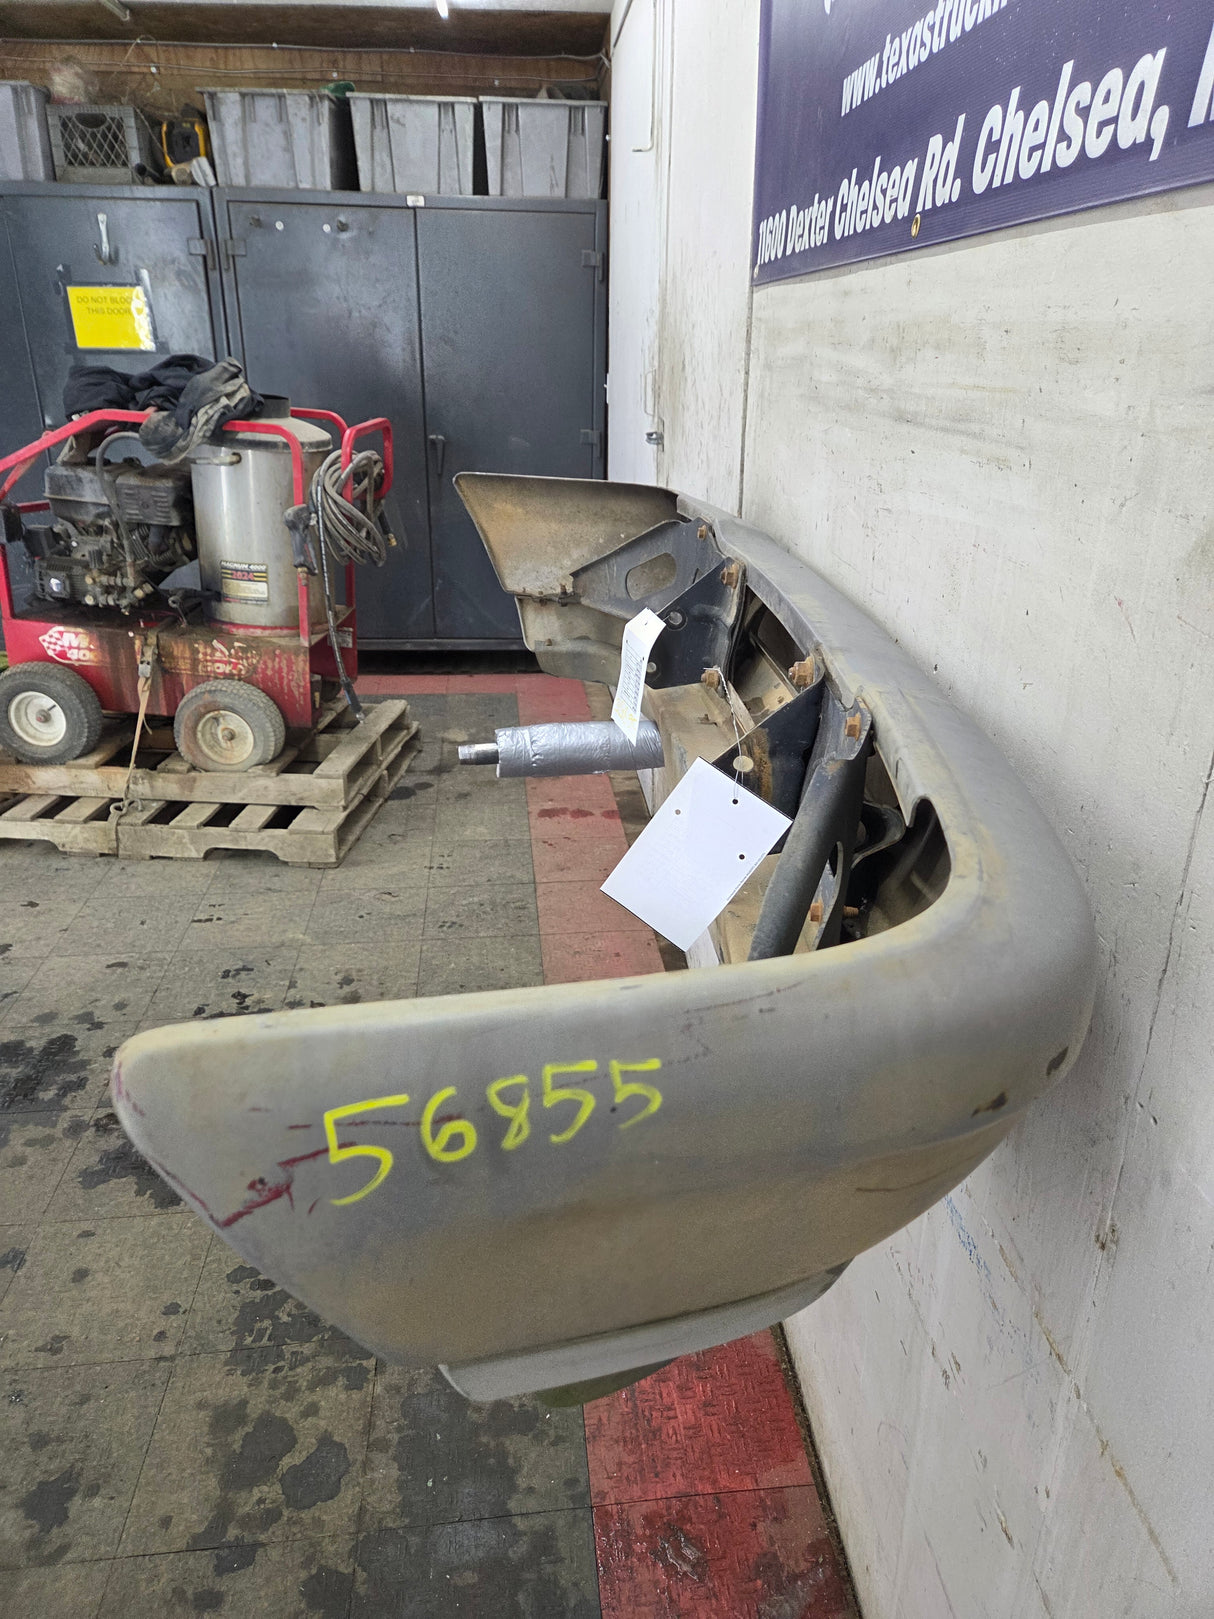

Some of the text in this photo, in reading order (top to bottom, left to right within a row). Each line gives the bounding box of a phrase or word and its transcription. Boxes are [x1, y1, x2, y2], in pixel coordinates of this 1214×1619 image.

[757, 209, 787, 265] 11600
[786, 192, 834, 256] Dexter
[834, 155, 918, 240] Chelsea
[916, 113, 966, 213] Rd.
[972, 46, 1170, 195] Chelsea,
[76, 295, 134, 304] DO NOT BLOC
[221, 560, 249, 570] MAGNUM
[323, 1057, 662, 1206] 56855
